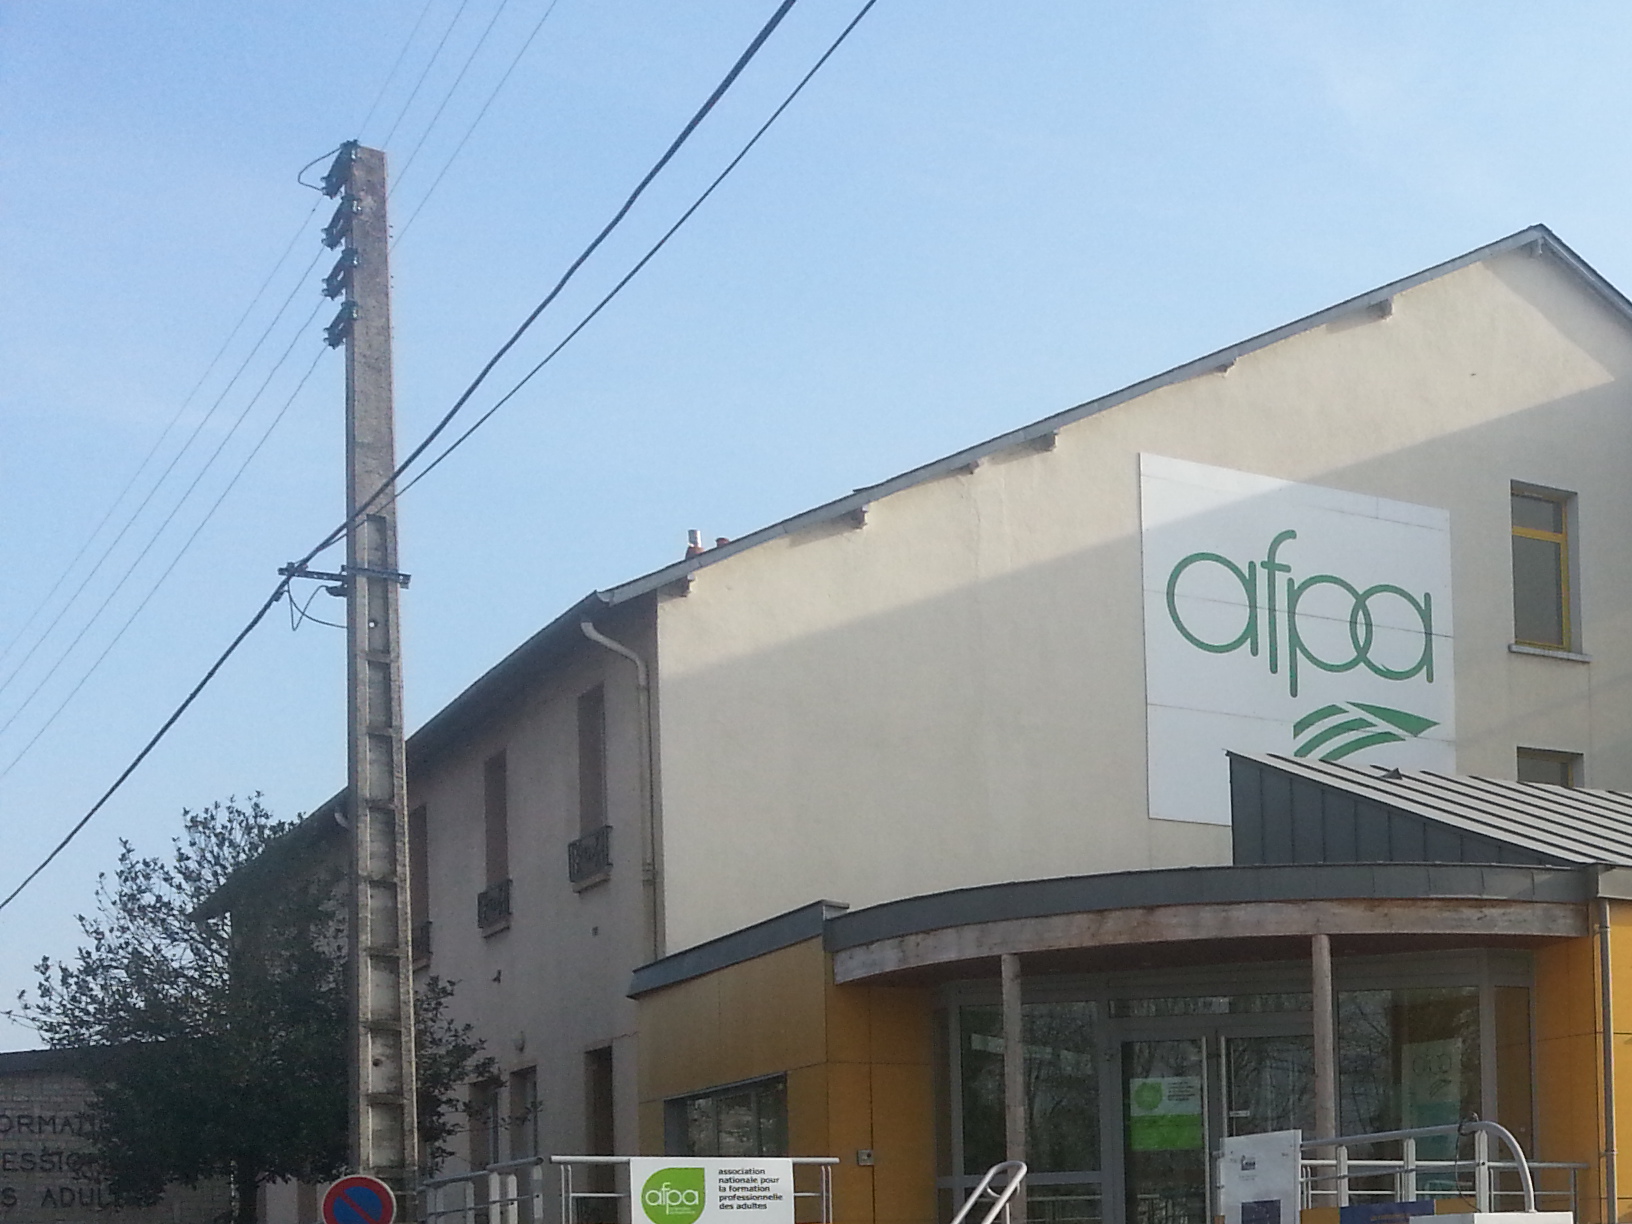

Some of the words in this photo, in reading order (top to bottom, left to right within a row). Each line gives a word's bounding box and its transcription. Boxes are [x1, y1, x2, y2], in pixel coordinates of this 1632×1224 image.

[1166, 529, 1434, 698] afpa
[718, 1176, 758, 1184] nationale
[760, 1177, 780, 1185] pour
[645, 1181, 699, 1215] afpa
[718, 1194, 783, 1202] professionnelle
[718, 1202, 734, 1210] des
[736, 1202, 768, 1210] adultes
